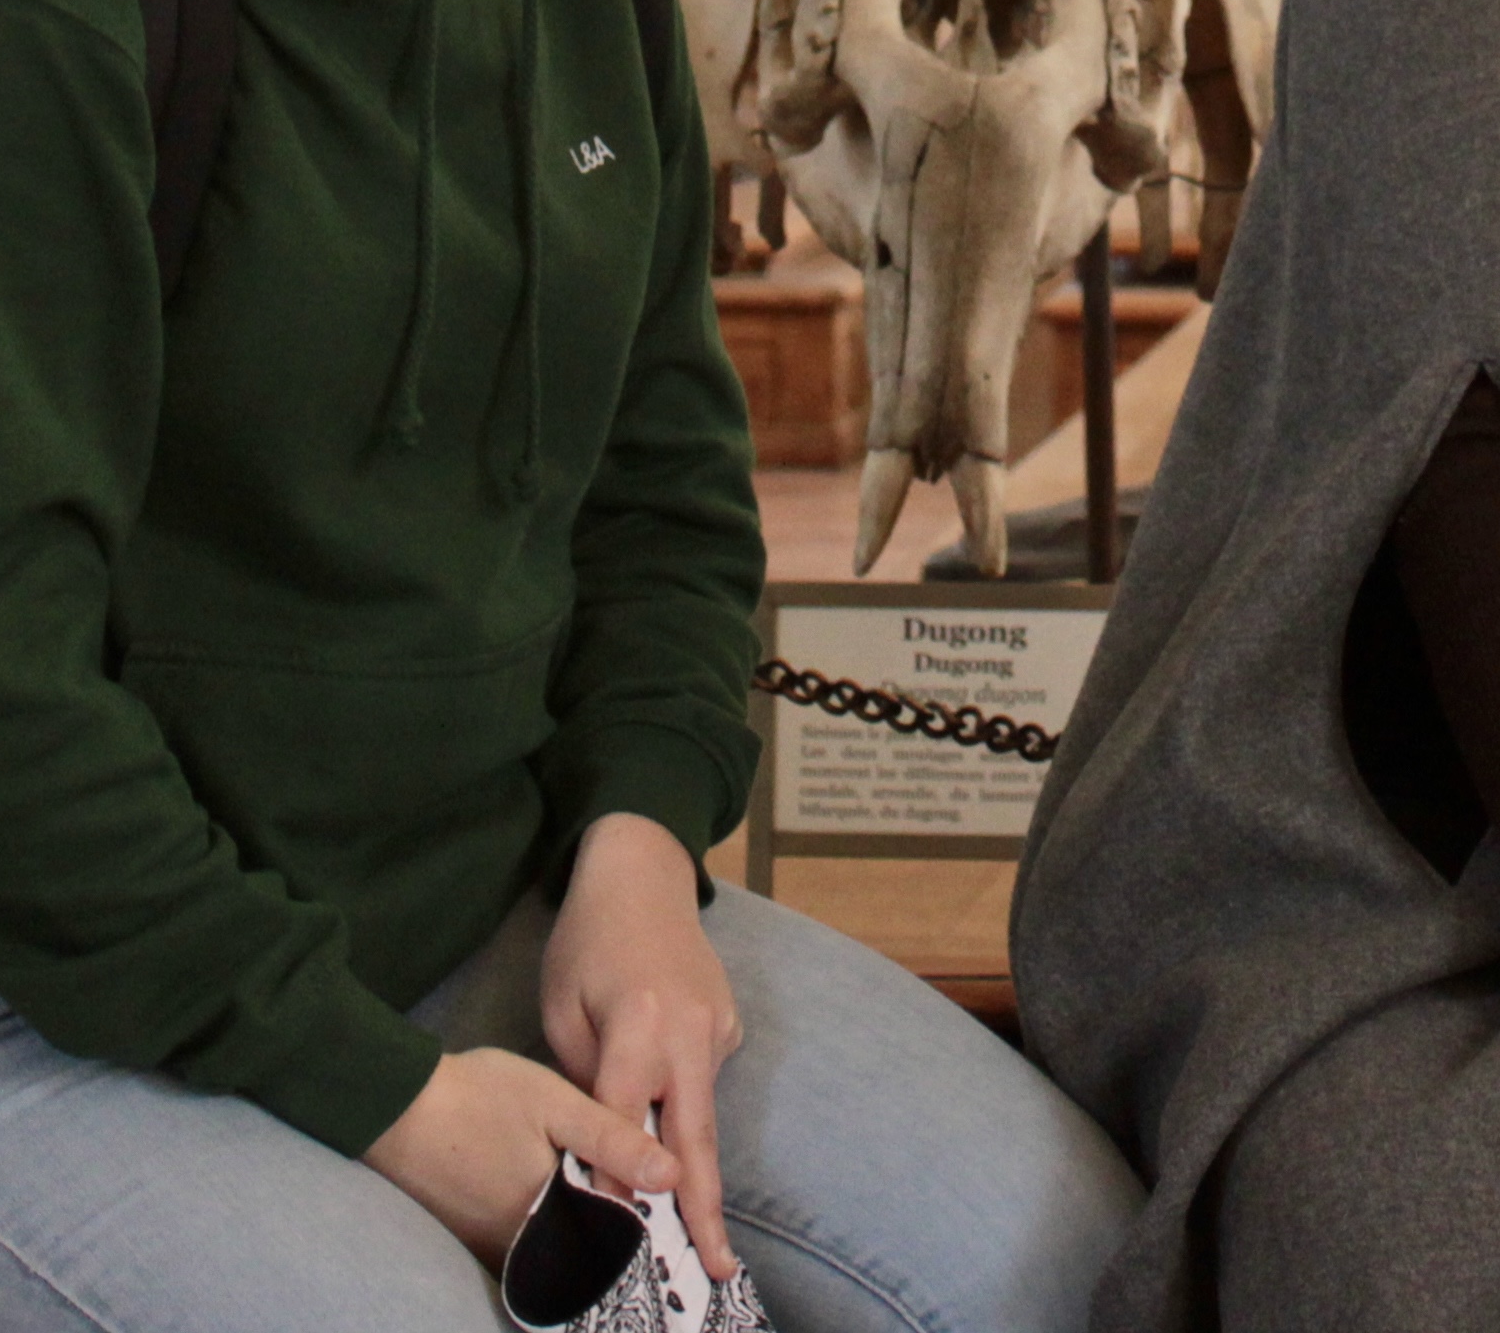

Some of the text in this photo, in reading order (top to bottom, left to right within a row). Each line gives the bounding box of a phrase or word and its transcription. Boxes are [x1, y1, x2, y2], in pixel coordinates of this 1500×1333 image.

[569, 135, 616, 174] L&A
[903, 616, 1029, 651] Dugong
[914, 651, 1015, 679] Dugong
[974, 683, 1047, 708] dugon
